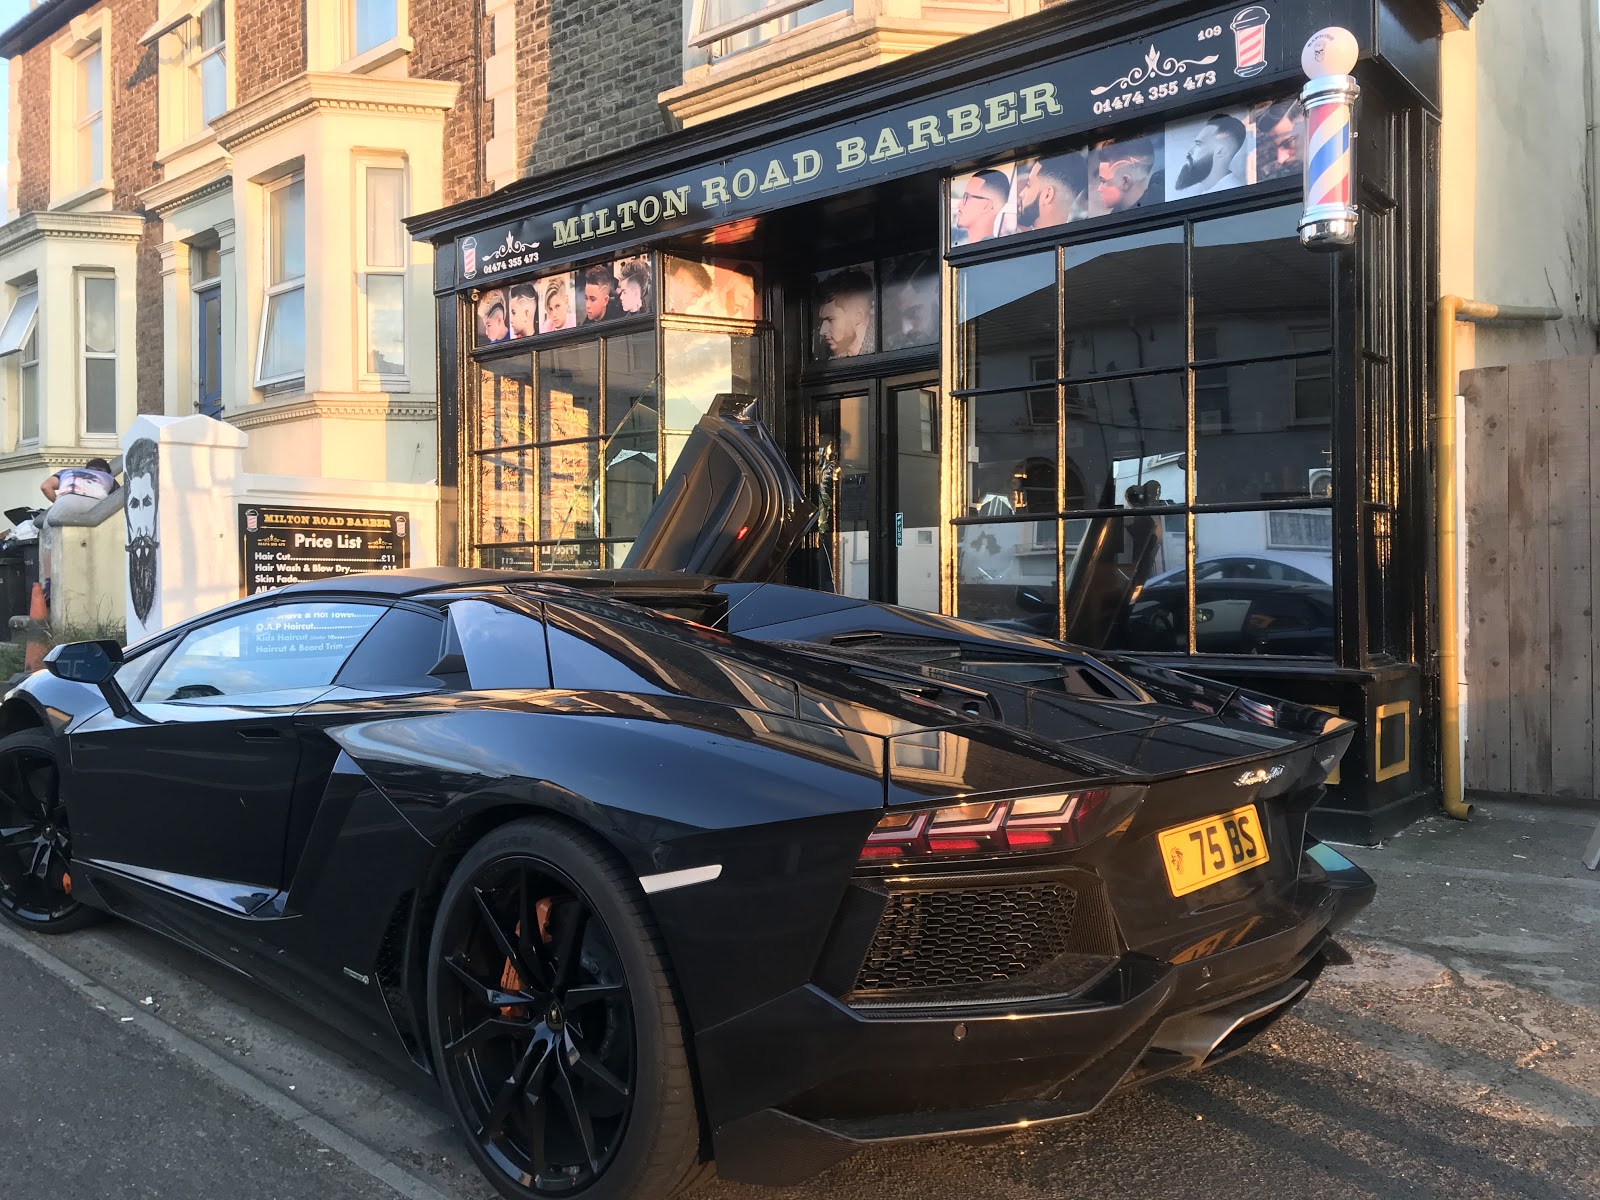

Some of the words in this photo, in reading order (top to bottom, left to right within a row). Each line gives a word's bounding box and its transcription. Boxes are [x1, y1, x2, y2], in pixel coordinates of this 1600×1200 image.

[1197, 25, 1223, 42] 109
[1093, 91, 1145, 115] 01474
[1148, 80, 1179, 101] 355
[1183, 70, 1217, 91] 473
[553, 185, 691, 248] MILTON
[702, 148, 824, 209] ROAD
[836, 82, 1063, 173] BARBER
[483, 261, 507, 274] 01474
[508, 256, 523, 268] 355
[524, 252, 539, 264] 473
[263, 514, 310, 524] MILTON
[312, 516, 345, 526] ROAD
[346, 517, 391, 528] BARBER
[294, 533, 333, 548] Price
[337, 534, 362, 549] List
[254, 552, 274, 560] Hair
[276, 552, 291, 561] Cut
[381, 554, 396, 562] £11
[254, 563, 274, 572] Hair
[276, 563, 301, 572] Wash
[303, 564, 310, 572] &
[312, 564, 334, 573] Blow
[335, 564, 351, 575] Dry
[255, 574, 277, 583] Skin
[277, 574, 298, 583] Fade
[255, 586, 268, 594] All
[256, 623, 281, 631] O.A.P
[278, 633, 308, 641] Haircut
[256, 645, 287, 653] Haircut
[1189, 826, 1226, 875] 75
[1223, 815, 1257, 864] BS
